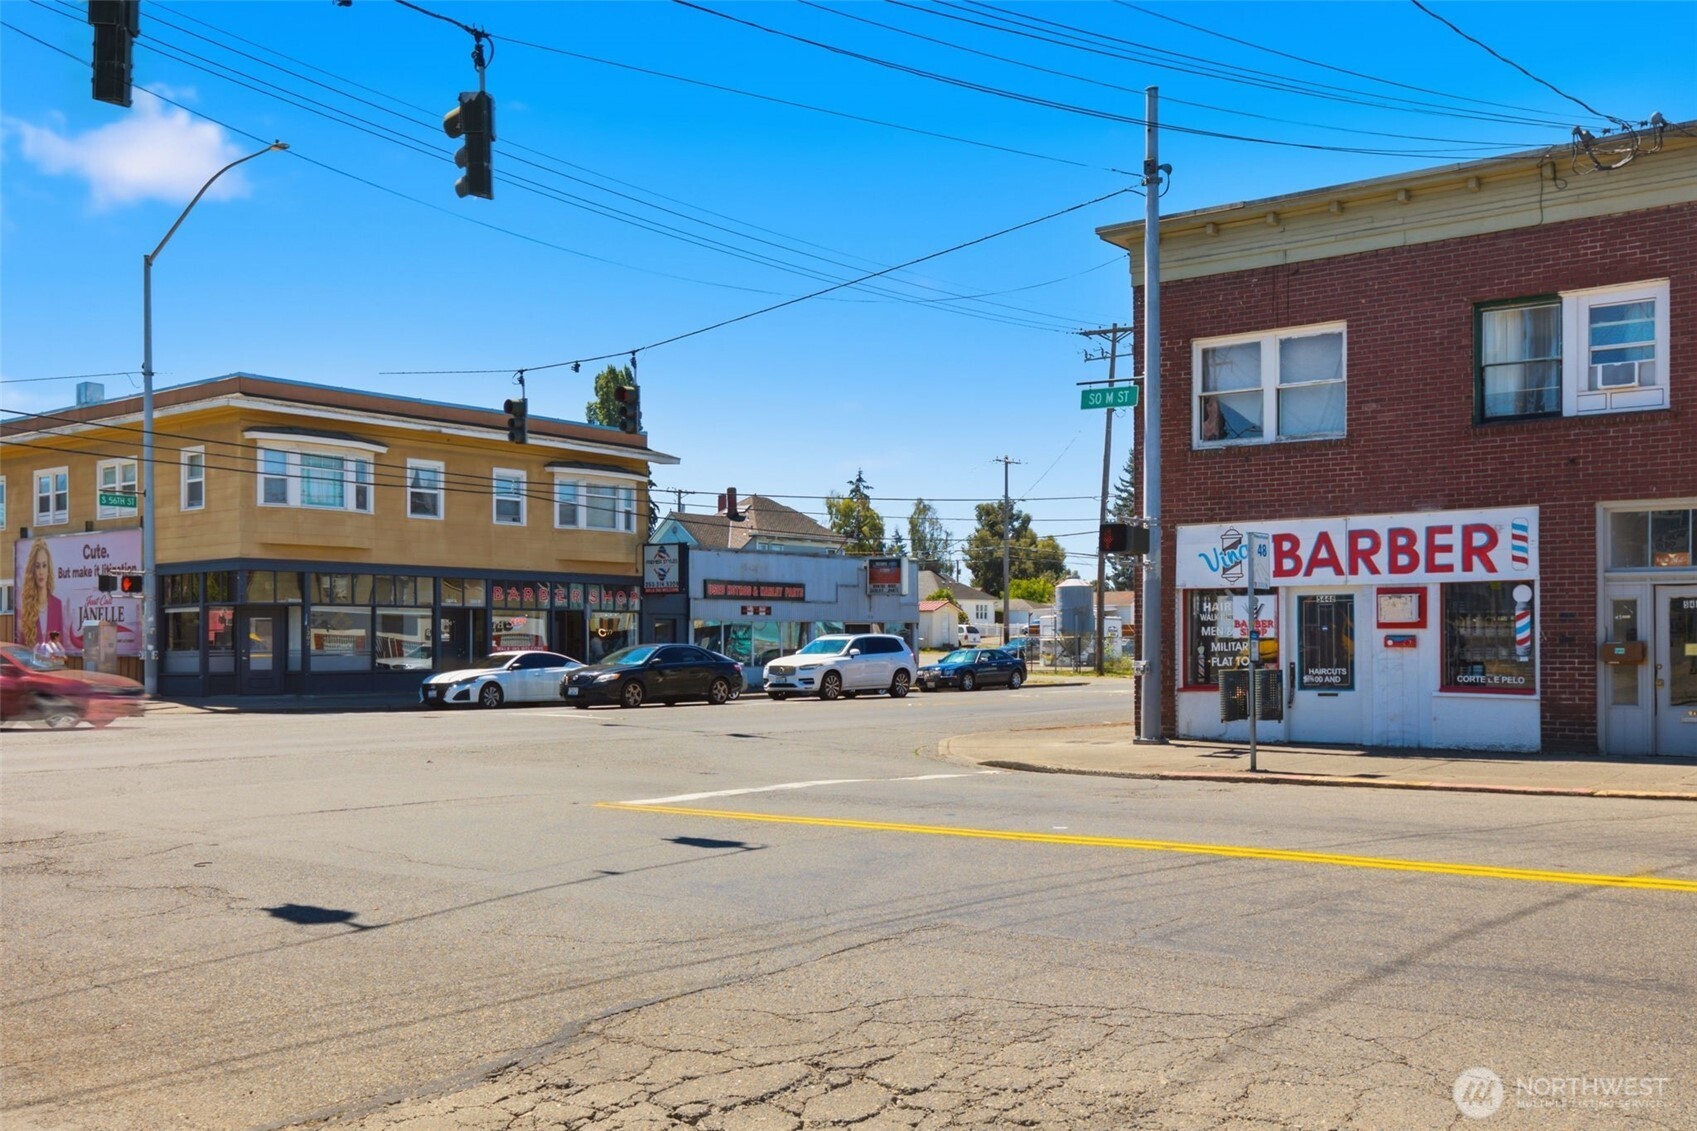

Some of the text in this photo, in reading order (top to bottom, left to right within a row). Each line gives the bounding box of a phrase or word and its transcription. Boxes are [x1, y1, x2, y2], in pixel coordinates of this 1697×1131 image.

[1088, 391, 1129, 405] SO M ST
[101, 496, 135, 506] S 56TH ST
[83, 544, 109, 560] Cute.
[1257, 543, 1267, 557] 48
[1271, 522, 1500, 579] BARBER
[58, 567, 71, 579] But
[72, 565, 93, 579] make
[94, 563, 100, 577] it
[492, 585, 638, 605] BARBER SHOP
[1203, 602, 1232, 612] HAIR
[77, 605, 125, 631] JANELLE
[1234, 619, 1274, 629] BABER
[1201, 626, 1223, 637] MEN
[1211, 641, 1249, 652] MILITAR
[1211, 656, 1250, 667] FLAT TO
[1308, 667, 1347, 676] HAIRCUTS
[1323, 675, 1341, 683] AND
[1456, 675, 1486, 683] CORTE
[1501, 676, 1526, 685] PELO
